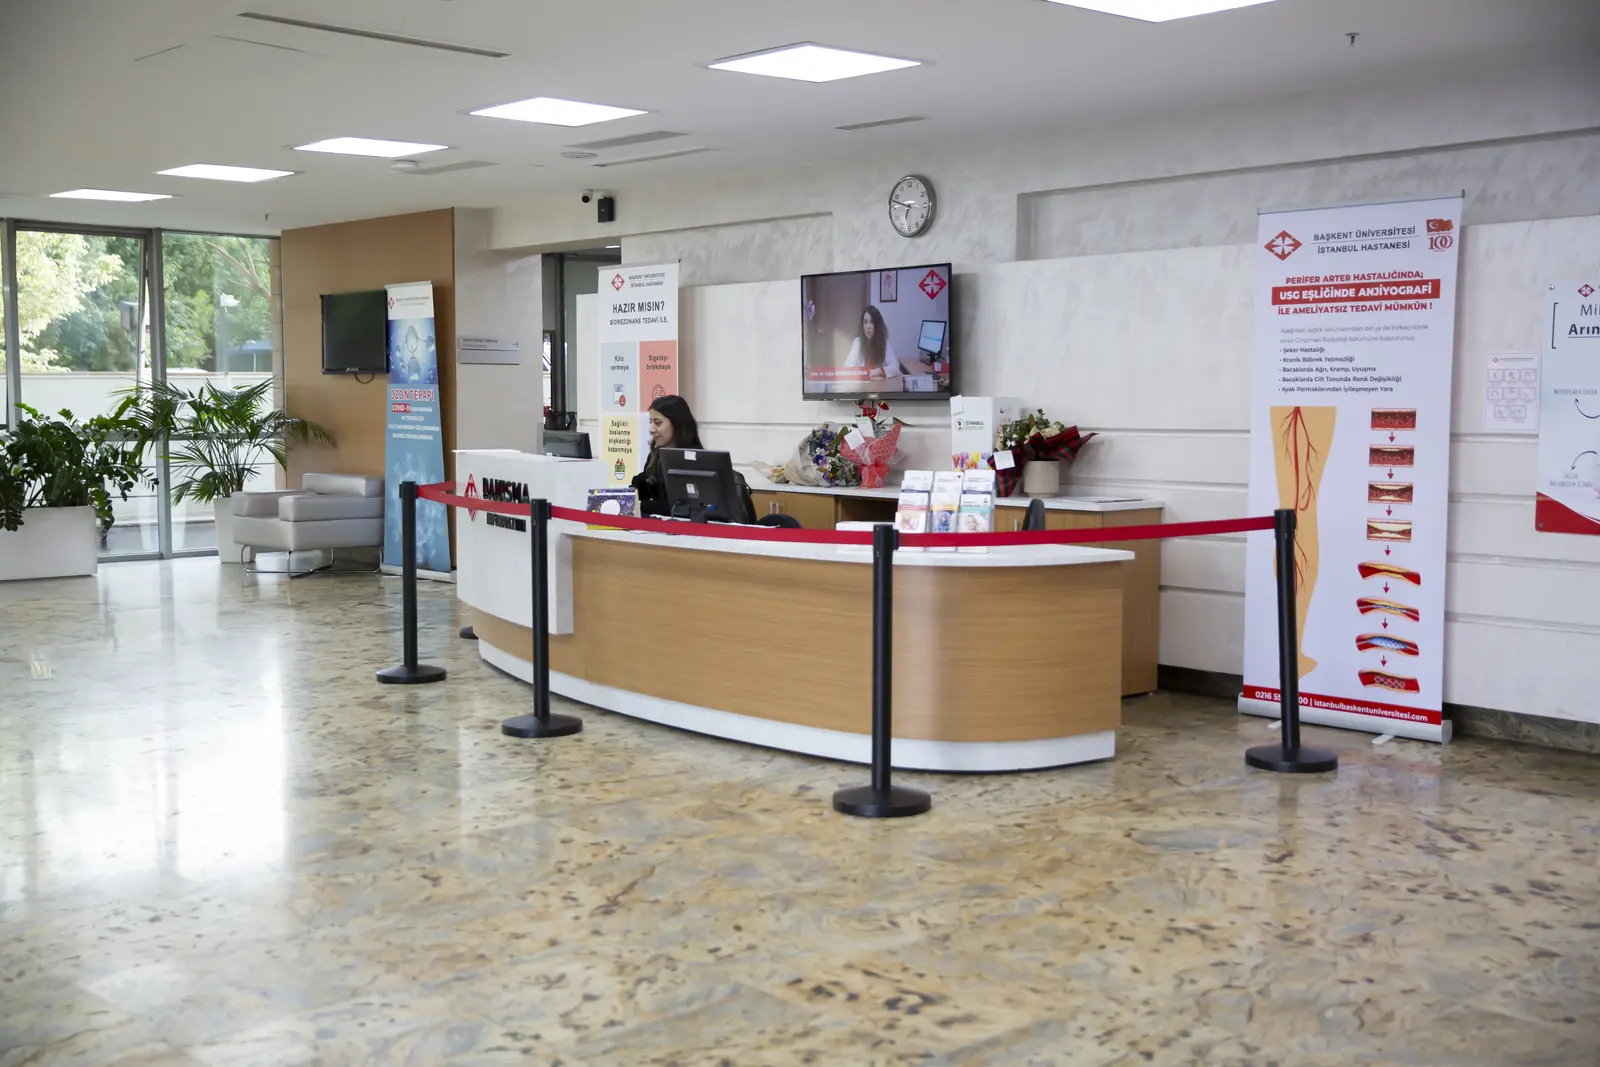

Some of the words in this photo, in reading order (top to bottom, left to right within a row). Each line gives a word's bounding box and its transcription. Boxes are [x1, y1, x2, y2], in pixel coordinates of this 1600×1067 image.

[1314, 232, 1352, 242] BAŞKENT
[1355, 226, 1416, 238] ÜNİVERSİTESİ
[1318, 244, 1358, 254] İSTANBUL
[1360, 240, 1410, 252] HASTANESİ
[1428, 235, 1454, 250] 100
[1286, 274, 1320, 285] PERİFER
[1322, 274, 1350, 283] ARTER
[1353, 270, 1424, 281] HASTALIĞINDA;
[1280, 290, 1300, 300] USG
[1302, 286, 1356, 302] EŞLİĞİNDE
[1358, 282, 1432, 297] ANJİYOGRAFİ
[612, 303, 636, 314] HAZIR
[638, 301, 665, 312] MISIN?
[1278, 305, 1290, 315] İLE
[1292, 304, 1348, 315] AMELİYATSIZ
[1350, 302, 1382, 312] TEDAVİ
[1384, 300, 1427, 311] MÜMKÜN
[643, 316, 658, 324] TEDAVİ
[1300, 346, 1325, 354] Hastalığı
[1314, 366, 1328, 374] Ağrı,
[391, 388, 434, 401] OZONTERAPİ
[392, 404, 411, 412] COVID-19
[611, 420, 628, 428] Sağlıklı
[1255, 691, 1272, 700] 0216
[1314, 700, 1428, 722] istanbulbaskentuniversitesi.com
